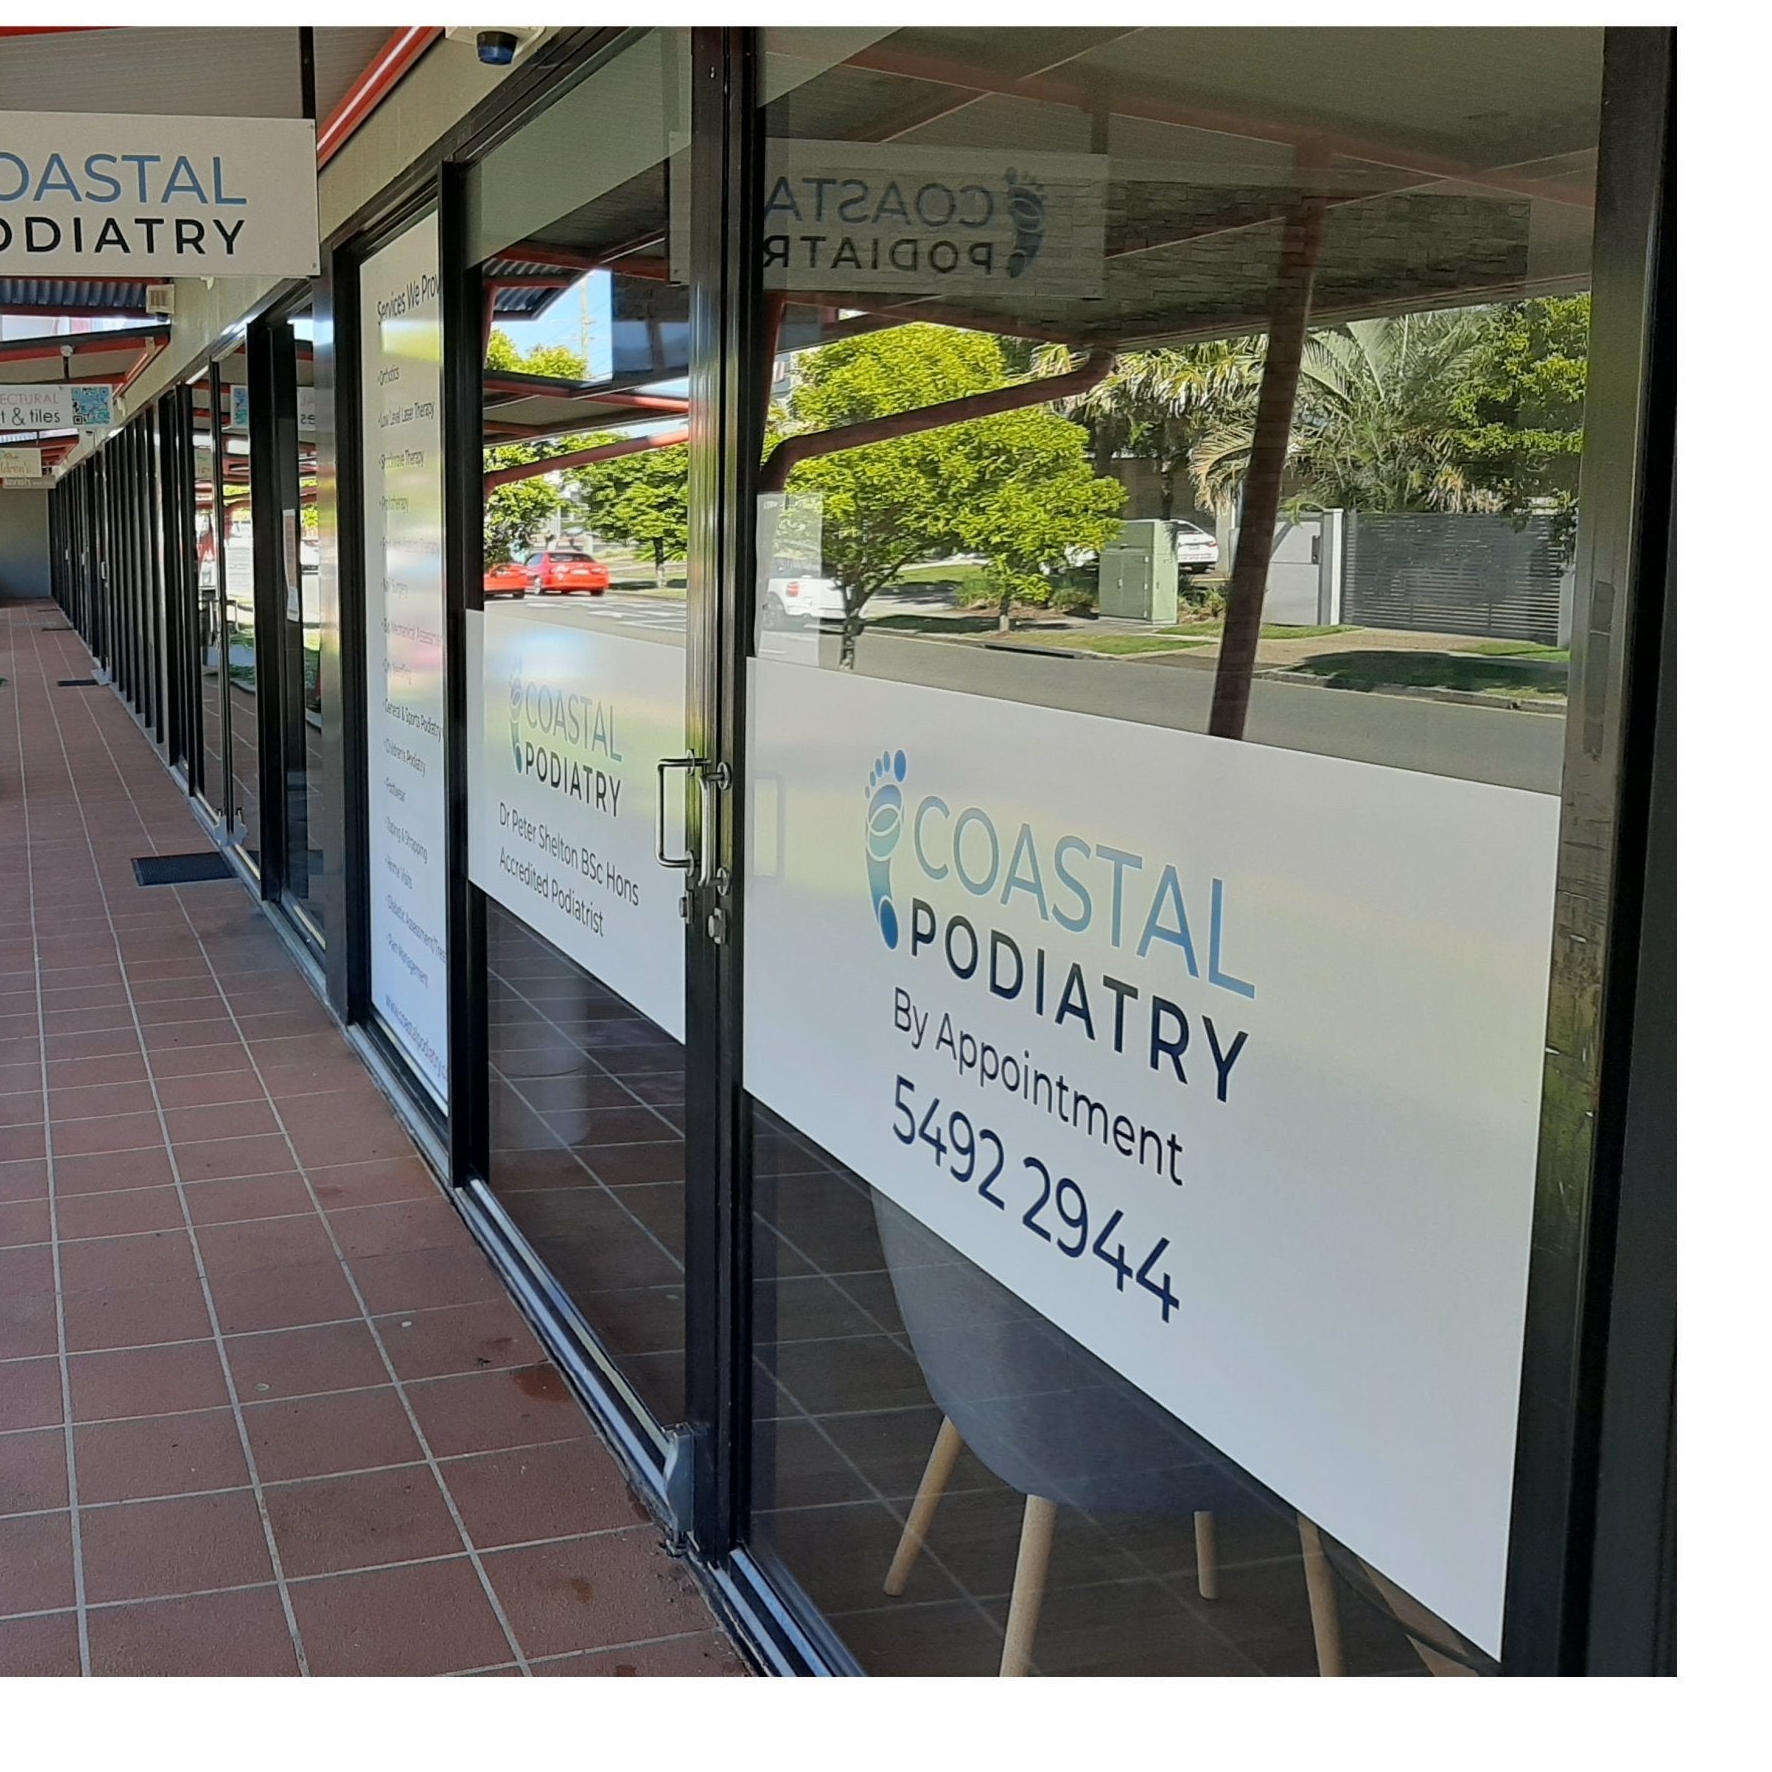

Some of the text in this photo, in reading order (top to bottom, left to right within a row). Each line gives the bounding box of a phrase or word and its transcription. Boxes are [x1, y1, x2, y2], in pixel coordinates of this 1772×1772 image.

[377, 291, 406, 326] Services
[406, 280, 420, 310] We
[11, 408, 26, 426] &
[30, 409, 61, 423] tiles
[525, 681, 623, 762] COASTAL
[525, 741, 622, 817] PODIATRY
[499, 802, 640, 906] Dr Peter Shelton BSc Hons
[499, 846, 604, 937] Accredited Podiatrist
[913, 794, 1256, 999] COASTAL
[910, 897, 1249, 1104] PODIATRY
[894, 986, 1184, 1185] By Appointment
[892, 1074, 1180, 1324] 5492 2944
